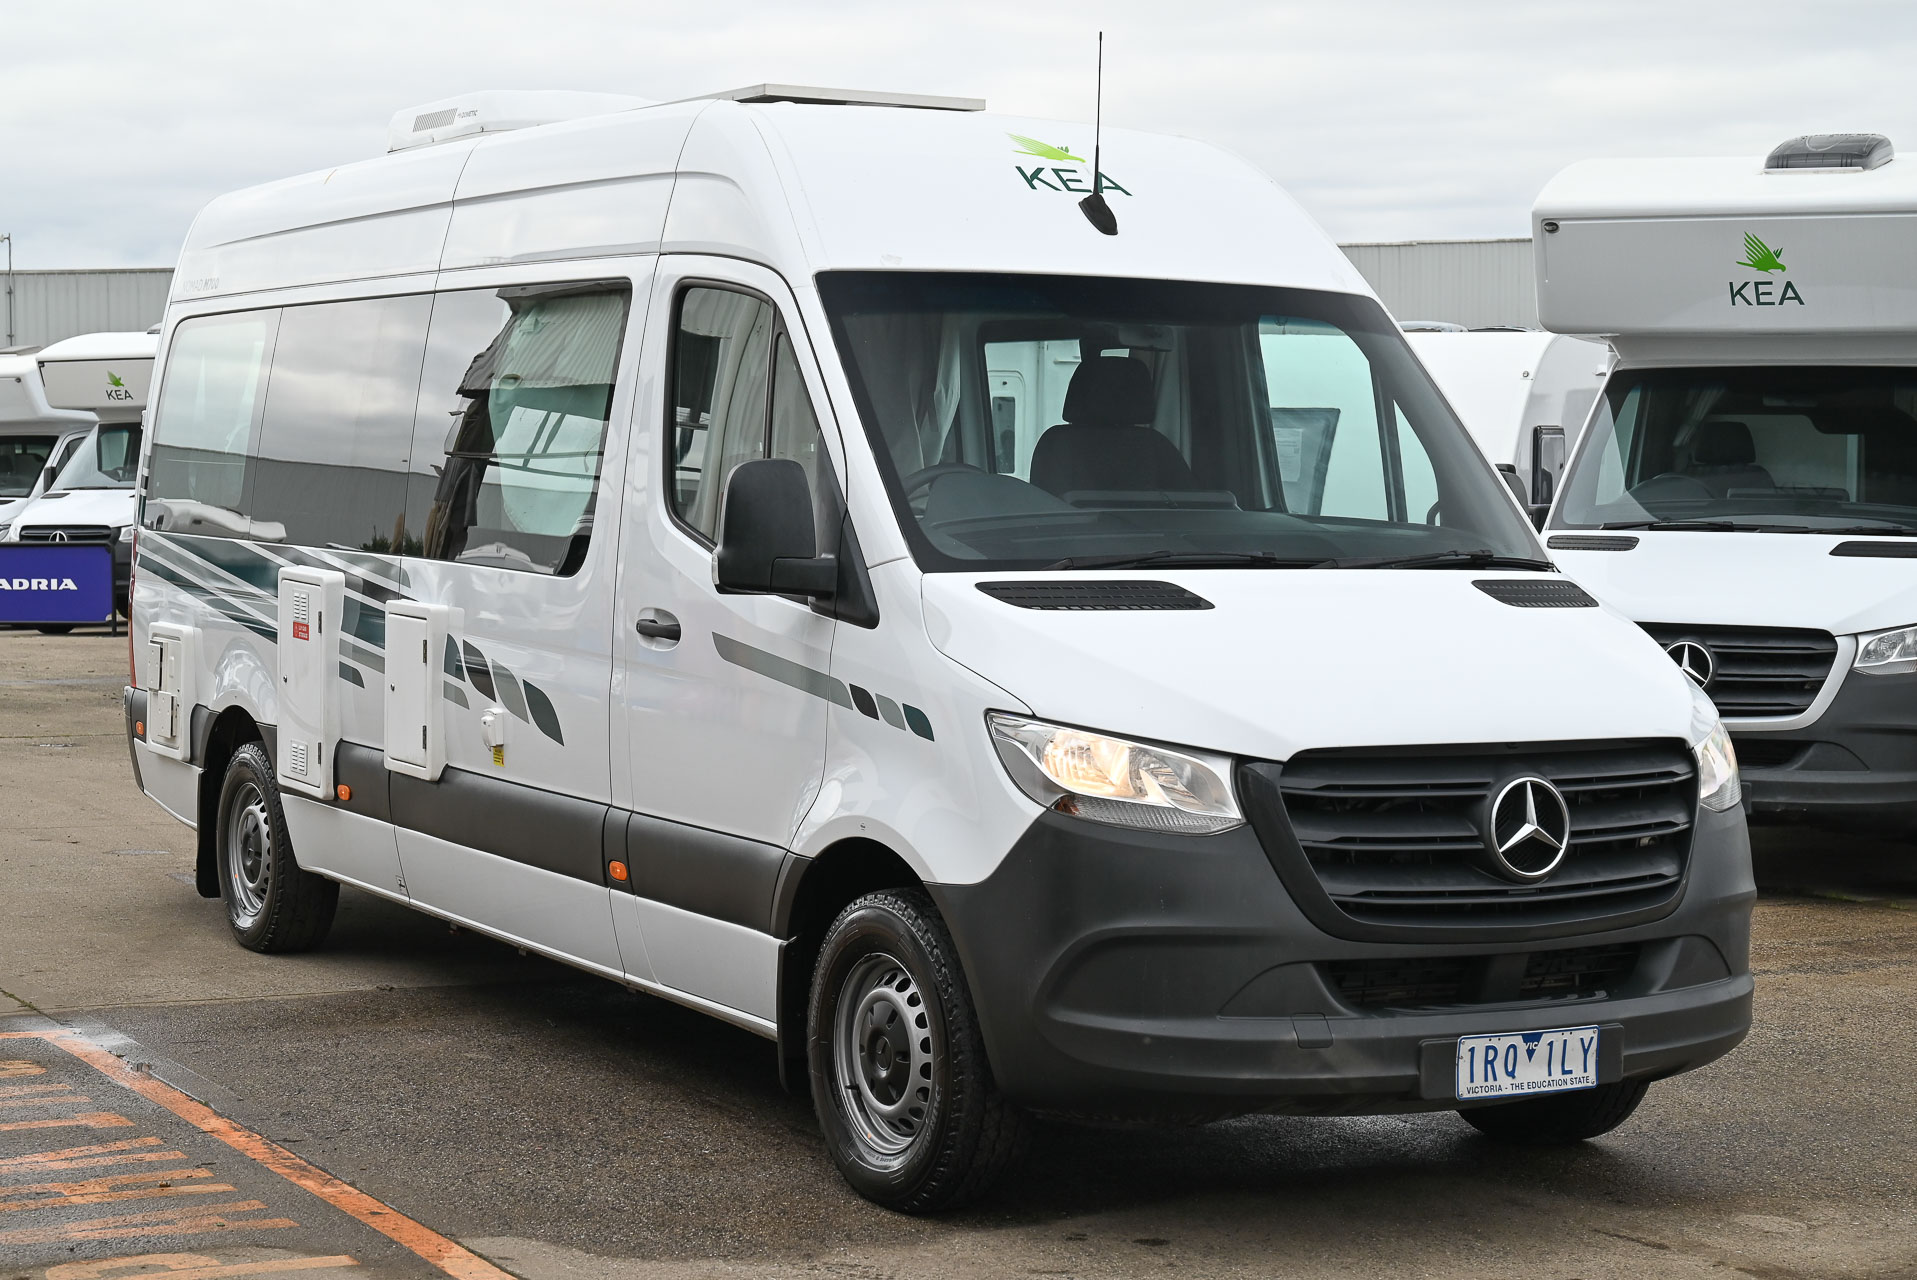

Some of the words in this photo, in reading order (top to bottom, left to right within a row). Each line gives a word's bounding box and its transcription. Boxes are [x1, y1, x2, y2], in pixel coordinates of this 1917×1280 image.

[1015, 165, 1133, 197] KEA
[1729, 280, 1806, 306] KEA
[105, 389, 134, 401] KEA
[0, 578, 78, 591] ADRIA
[1523, 1041, 1539, 1051] VIC
[1468, 1043, 1518, 1084] 1RQ
[1546, 1036, 1595, 1077] 1LY
[1466, 1084, 1503, 1095] VICTORIA
[1510, 1082, 1525, 1091] THE
[1527, 1079, 1568, 1089] EDUCATION
[1569, 1076, 1590, 1085] STATE
